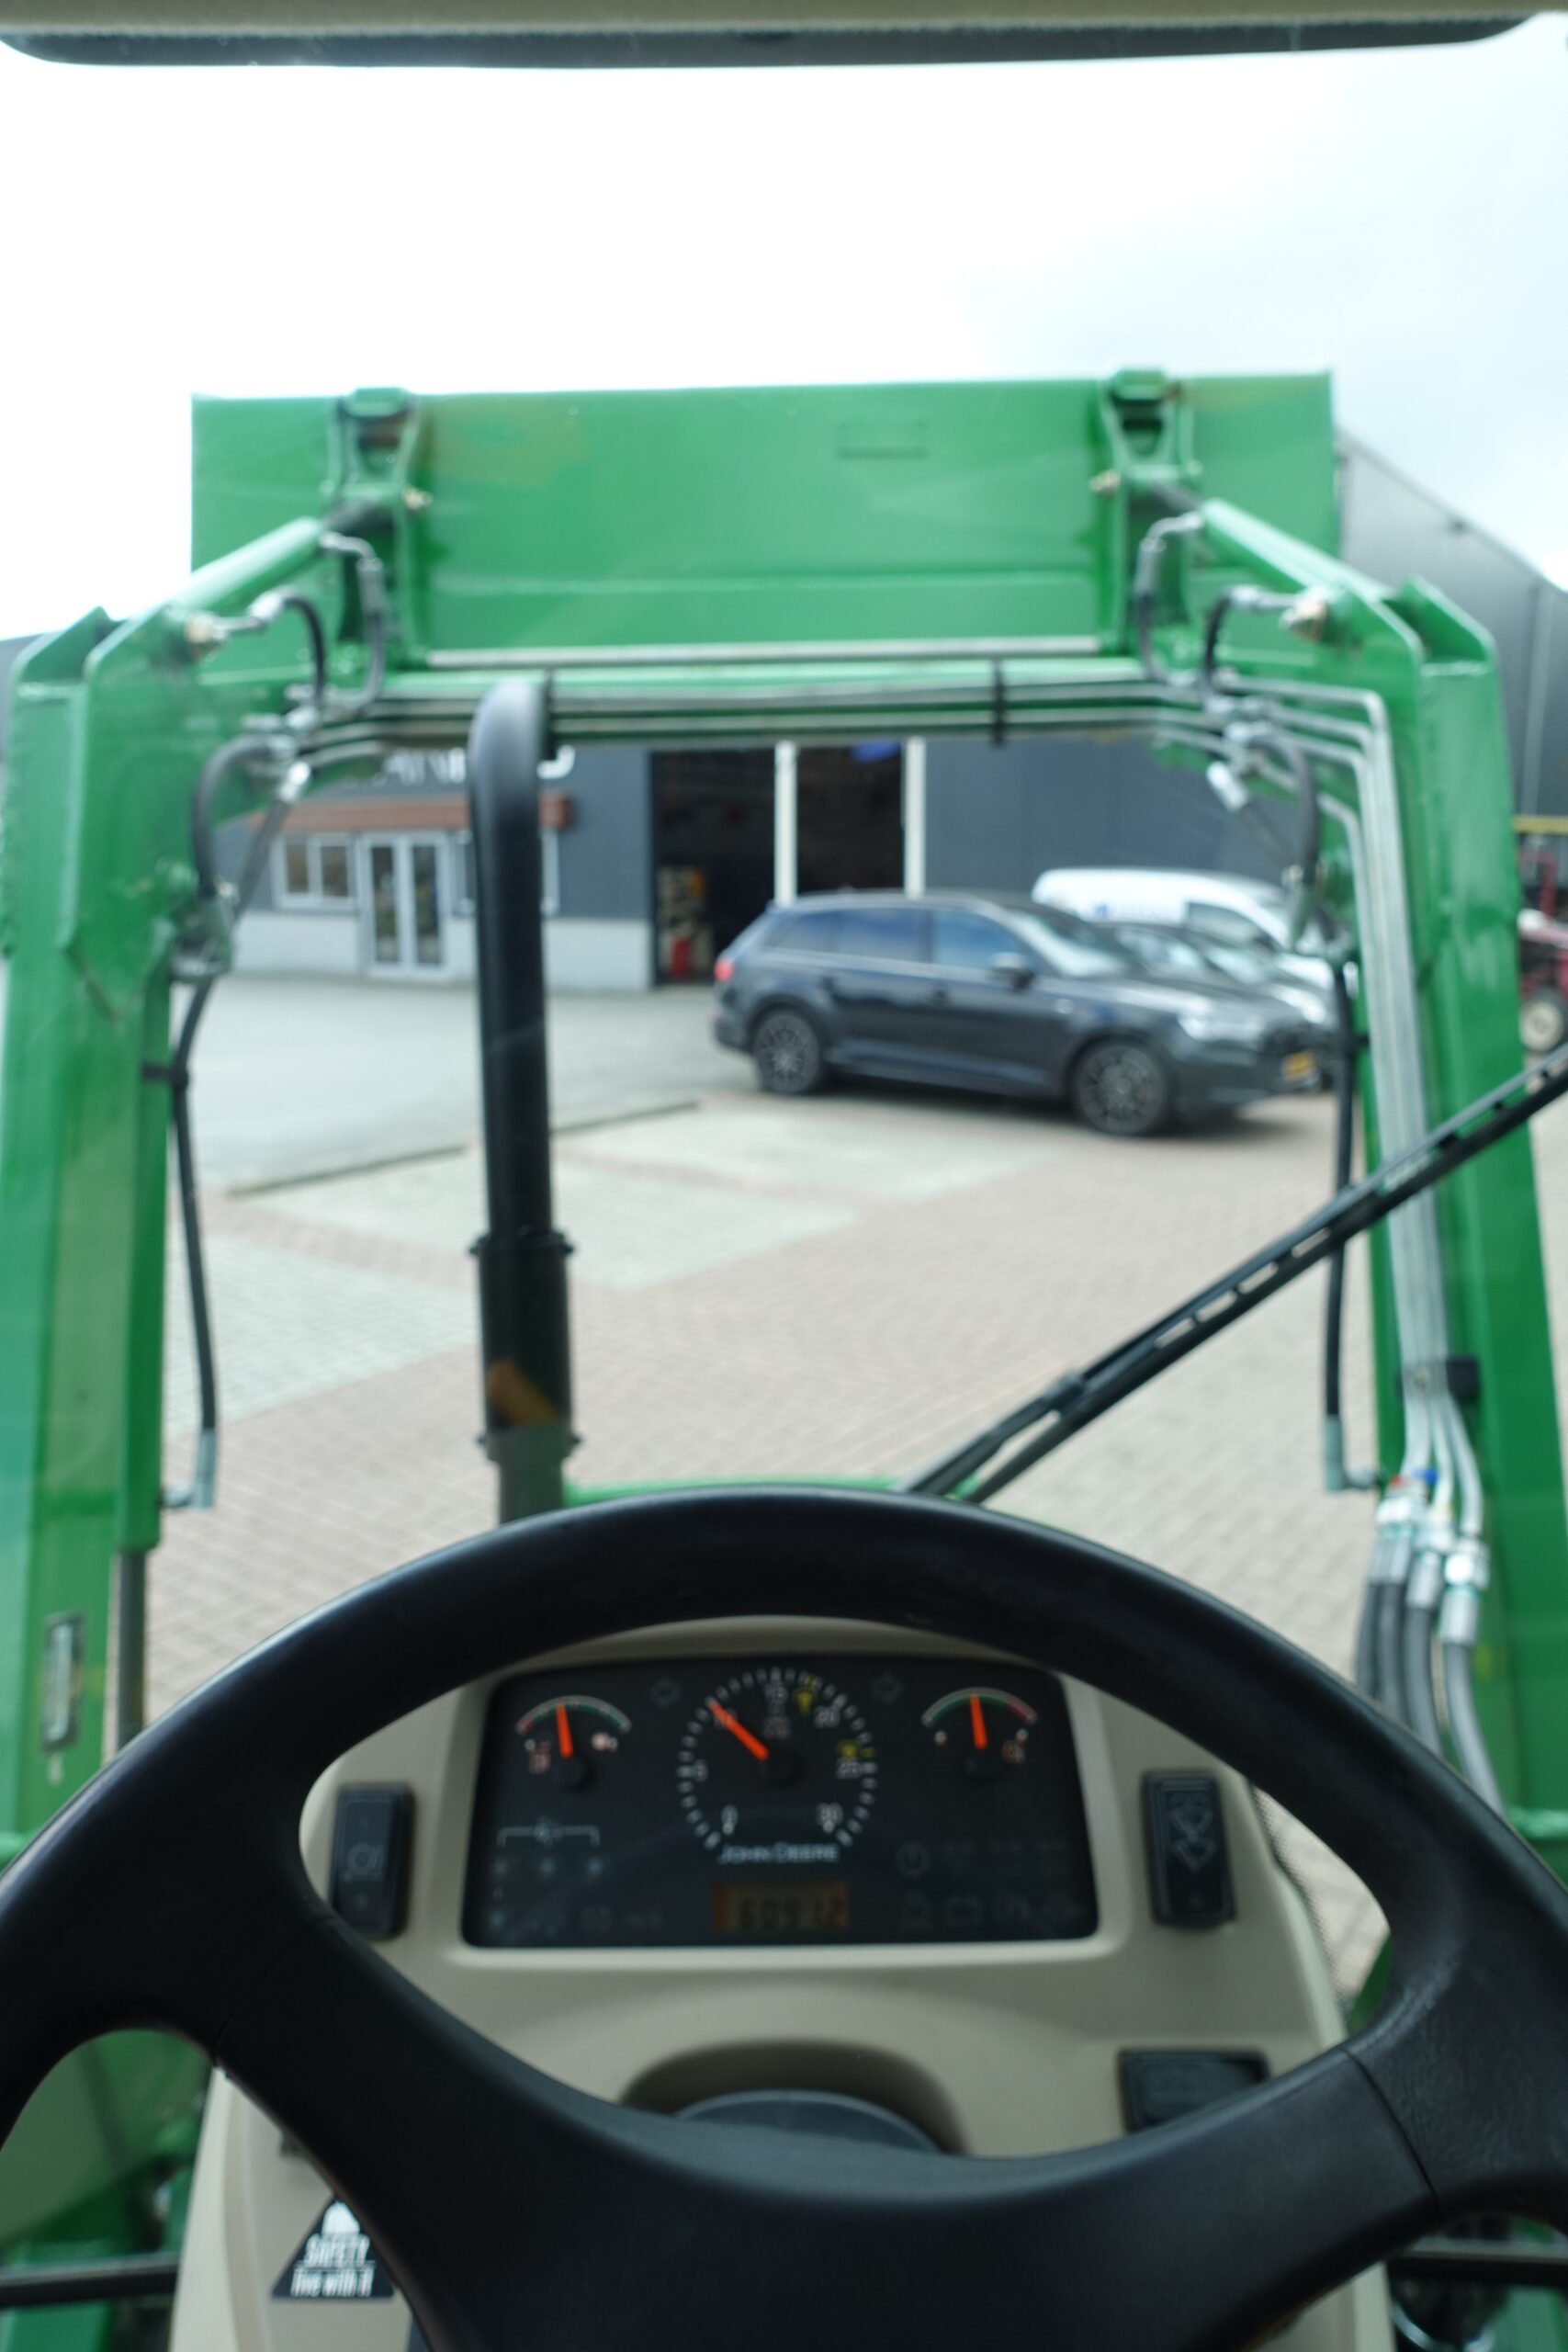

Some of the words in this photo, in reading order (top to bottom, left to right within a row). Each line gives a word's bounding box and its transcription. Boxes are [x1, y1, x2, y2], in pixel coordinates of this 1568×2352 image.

[773, 1841, 840, 1863] DEERE
[303, 2233, 370, 2268] SAFETY
[322, 2267, 356, 2297] with
[357, 2266, 375, 2297] it
